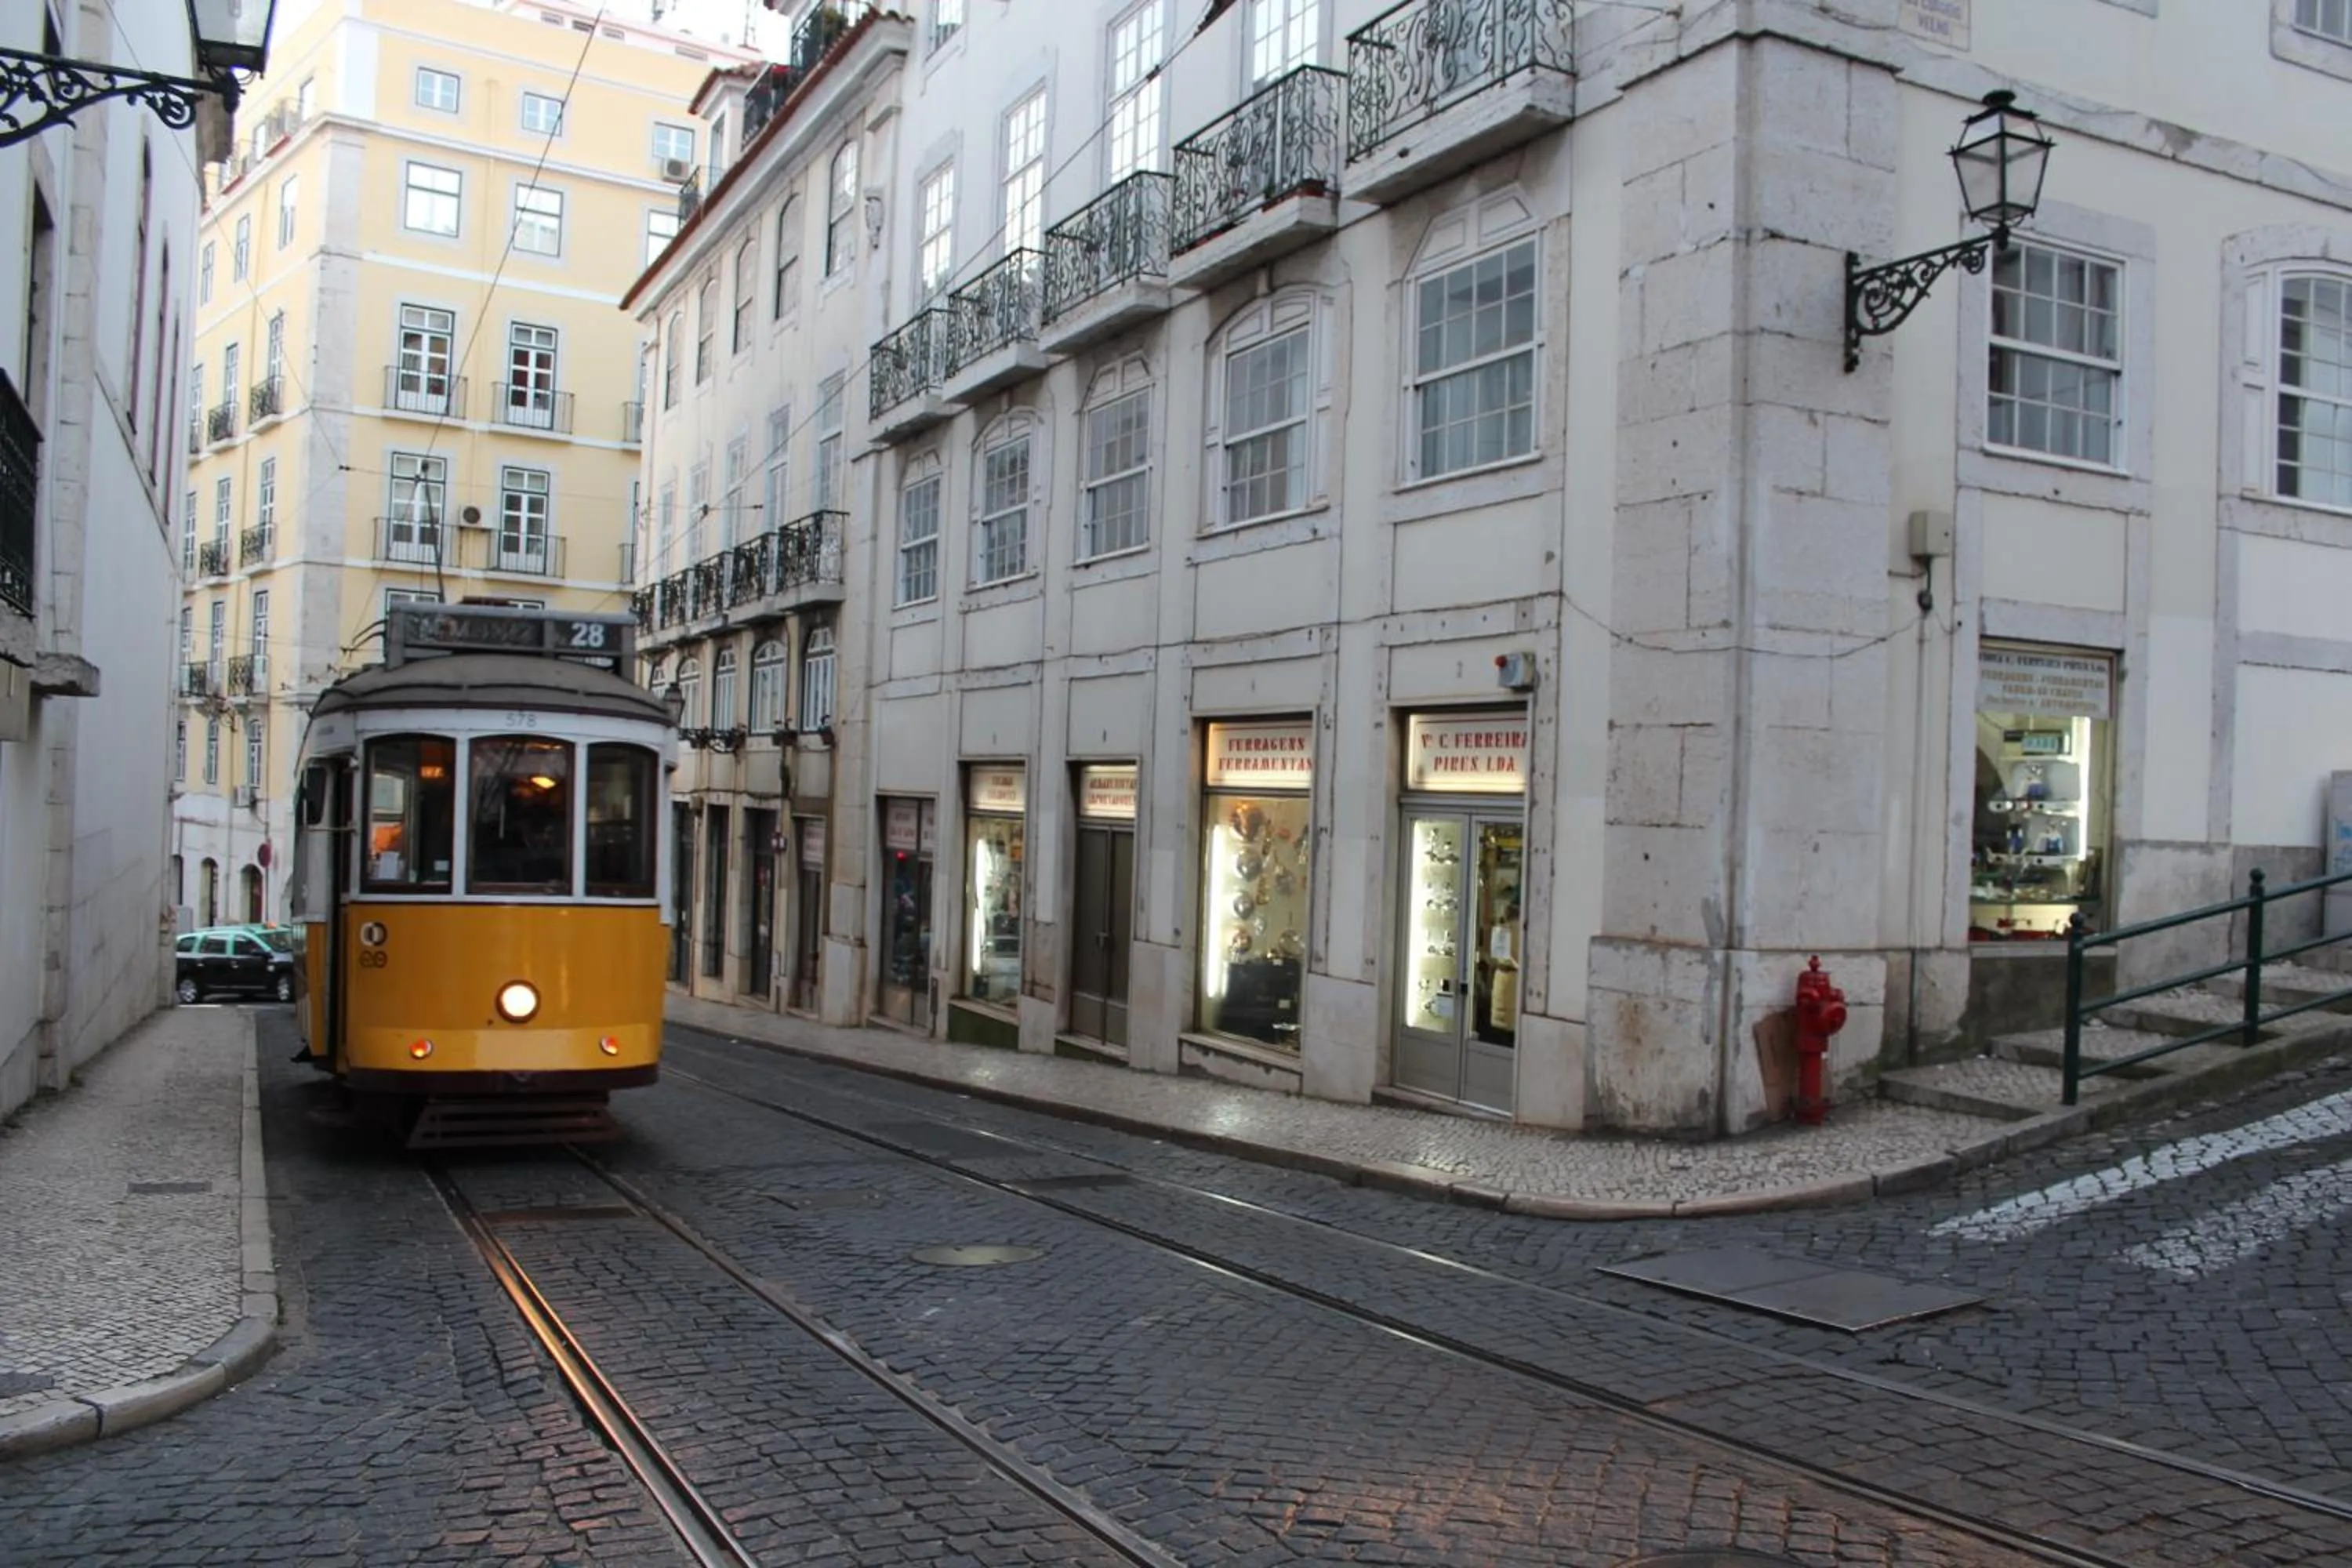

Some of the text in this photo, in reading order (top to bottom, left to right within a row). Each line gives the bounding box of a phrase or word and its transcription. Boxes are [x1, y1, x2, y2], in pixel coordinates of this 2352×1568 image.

[571, 622, 604, 647] 28
[505, 713, 538, 728] 578
[1228, 737, 1305, 752] FERRAGENS
[1433, 755, 1479, 771] PIRES
